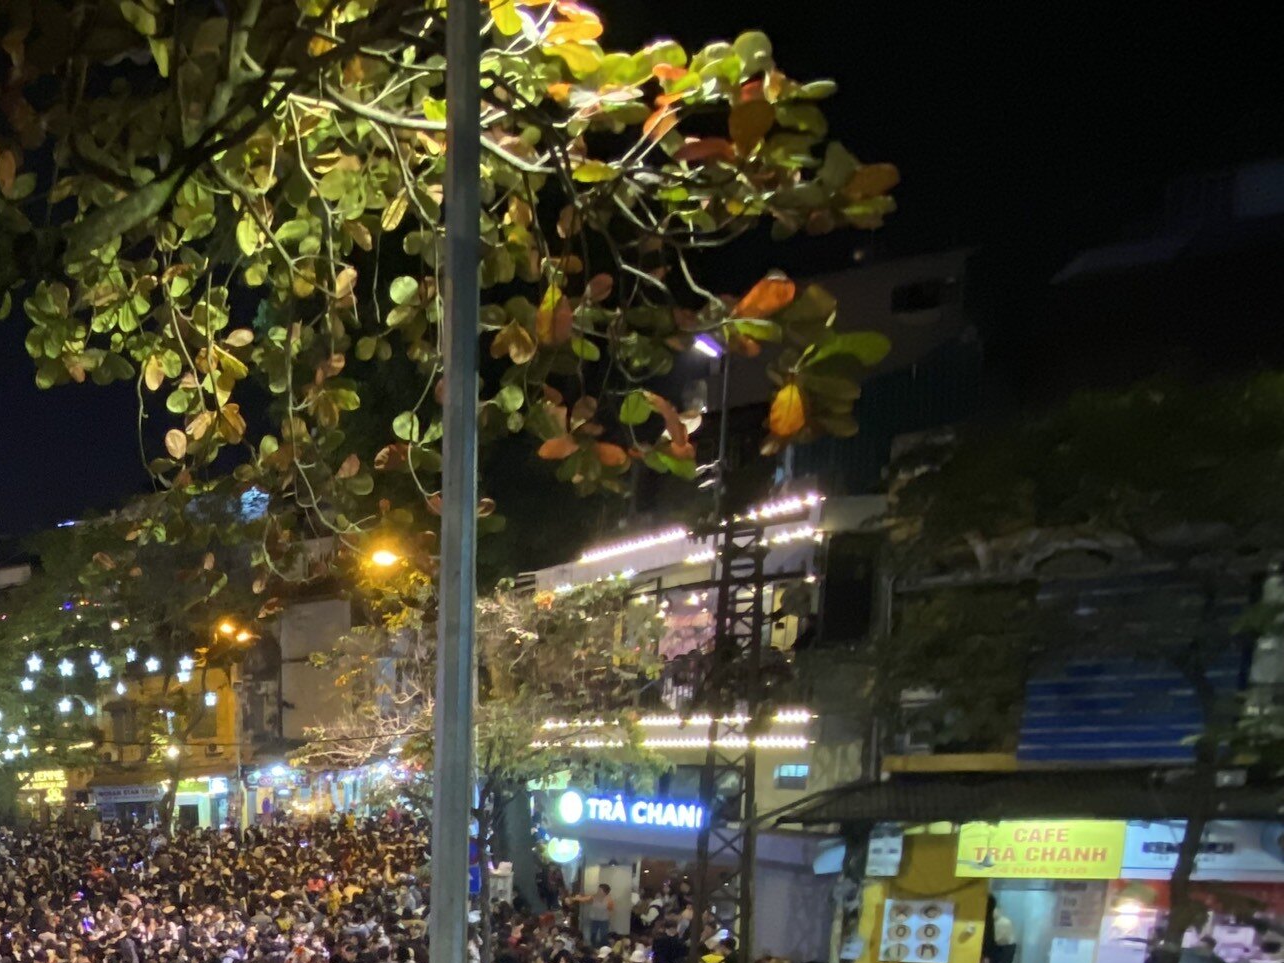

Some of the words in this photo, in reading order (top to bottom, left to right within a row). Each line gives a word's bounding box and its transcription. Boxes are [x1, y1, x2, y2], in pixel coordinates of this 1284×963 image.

[587, 794, 626, 823] TRÀ
[1013, 828, 1069, 843] CAFE
[1025, 846, 1108, 863] CHANH
